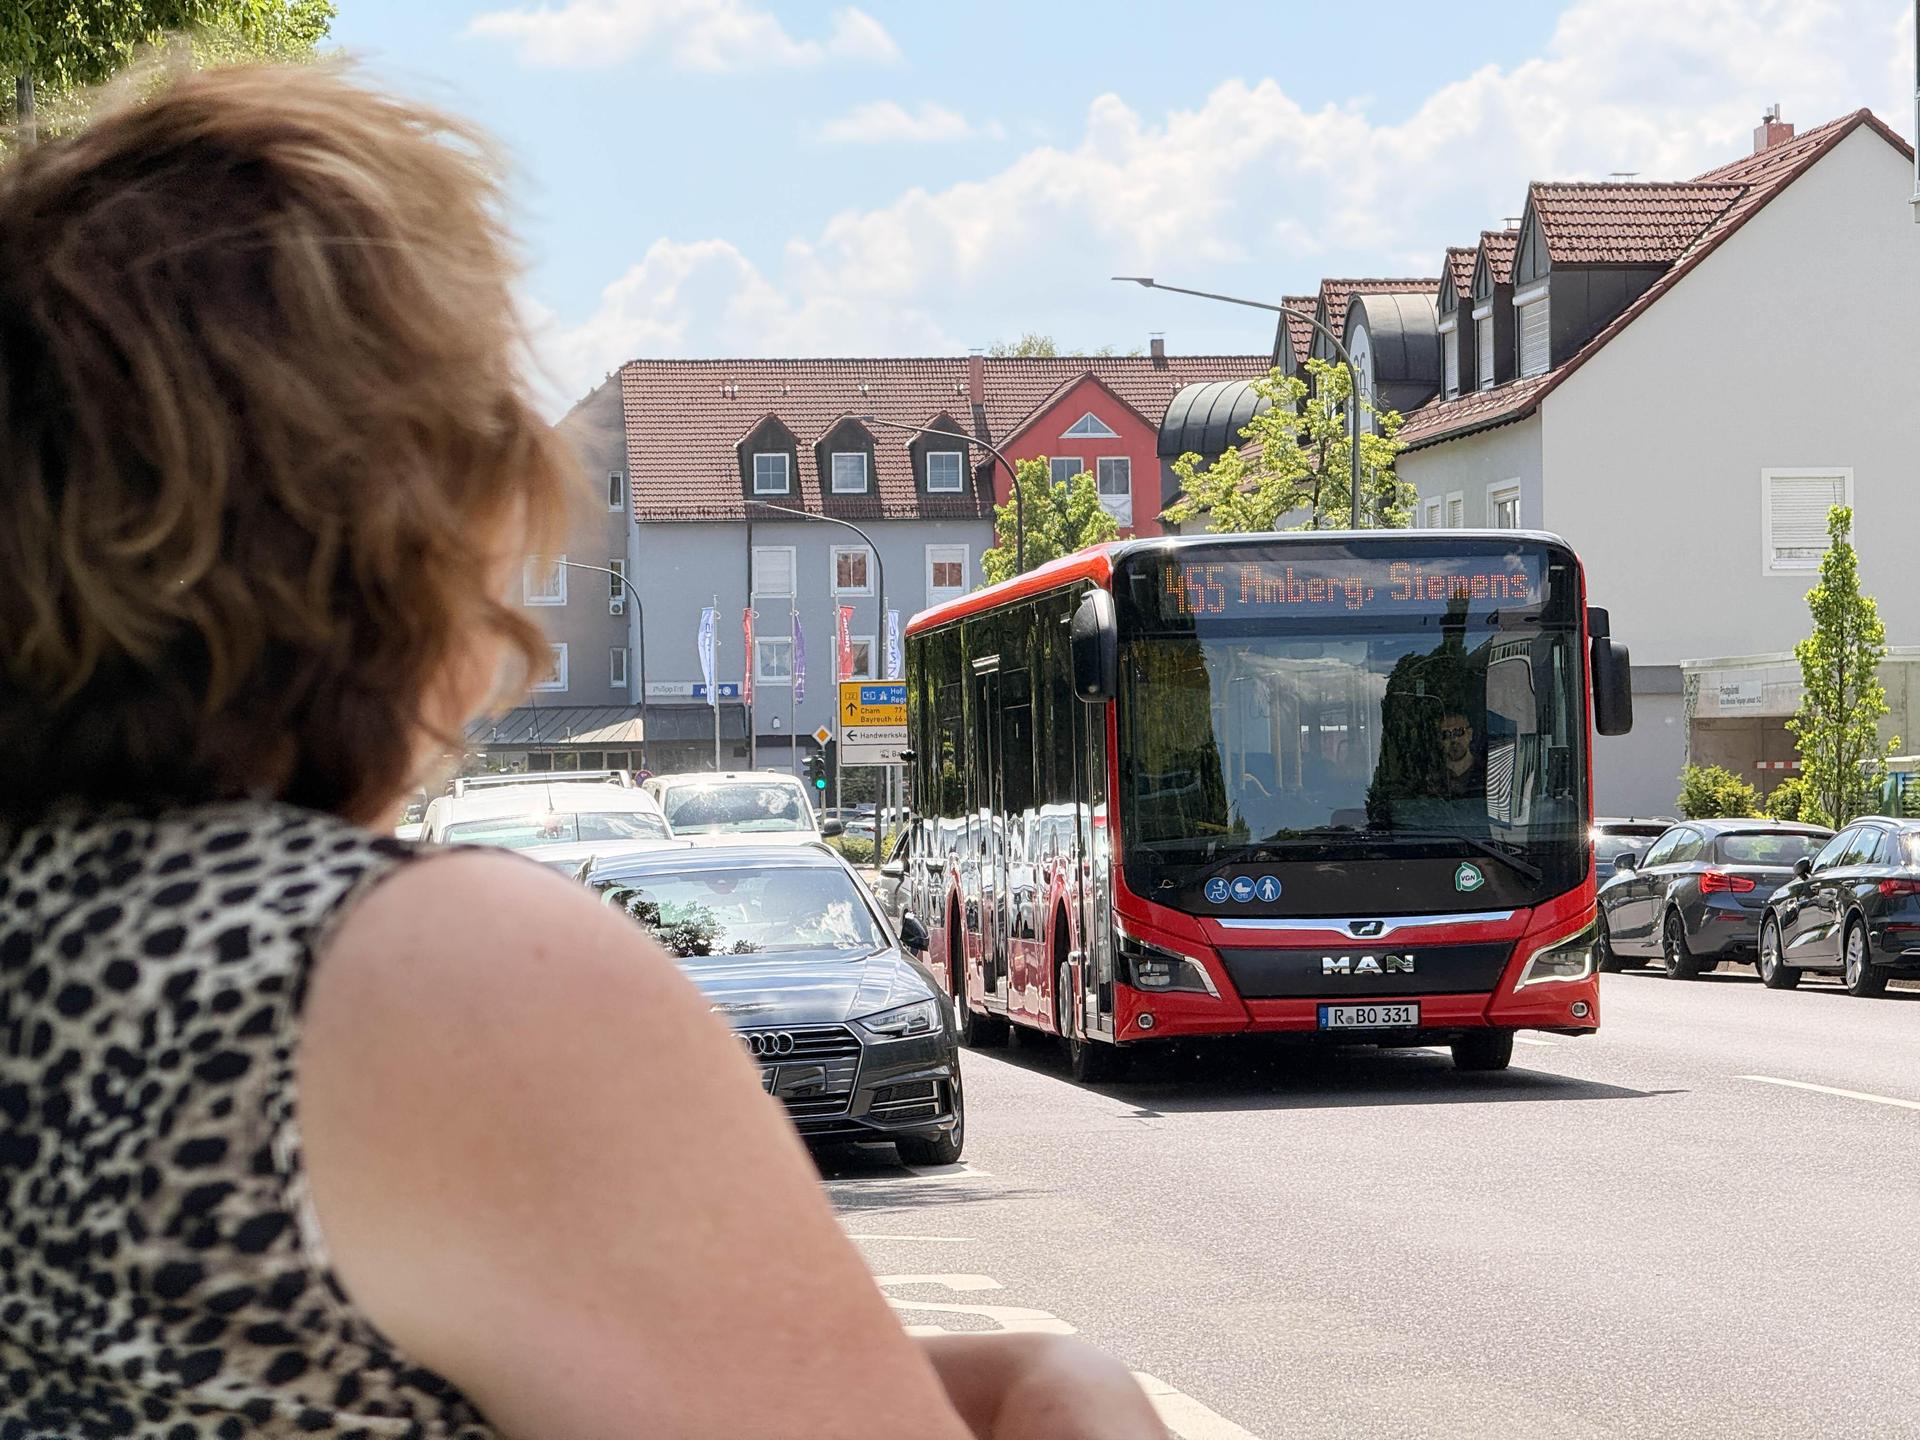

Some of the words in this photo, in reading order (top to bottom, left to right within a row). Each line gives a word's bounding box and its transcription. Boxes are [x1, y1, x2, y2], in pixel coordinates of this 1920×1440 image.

[1166, 566, 1225, 614] 455
[1241, 565, 1374, 610] Amberg,
[1390, 561, 1529, 600] Siemens
[860, 716, 891, 724] Bayreuth
[1322, 955, 1415, 974] MAN
[1334, 1009, 1344, 1024] R
[1356, 1008, 1377, 1023] BO
[1382, 1007, 1412, 1023] 331
